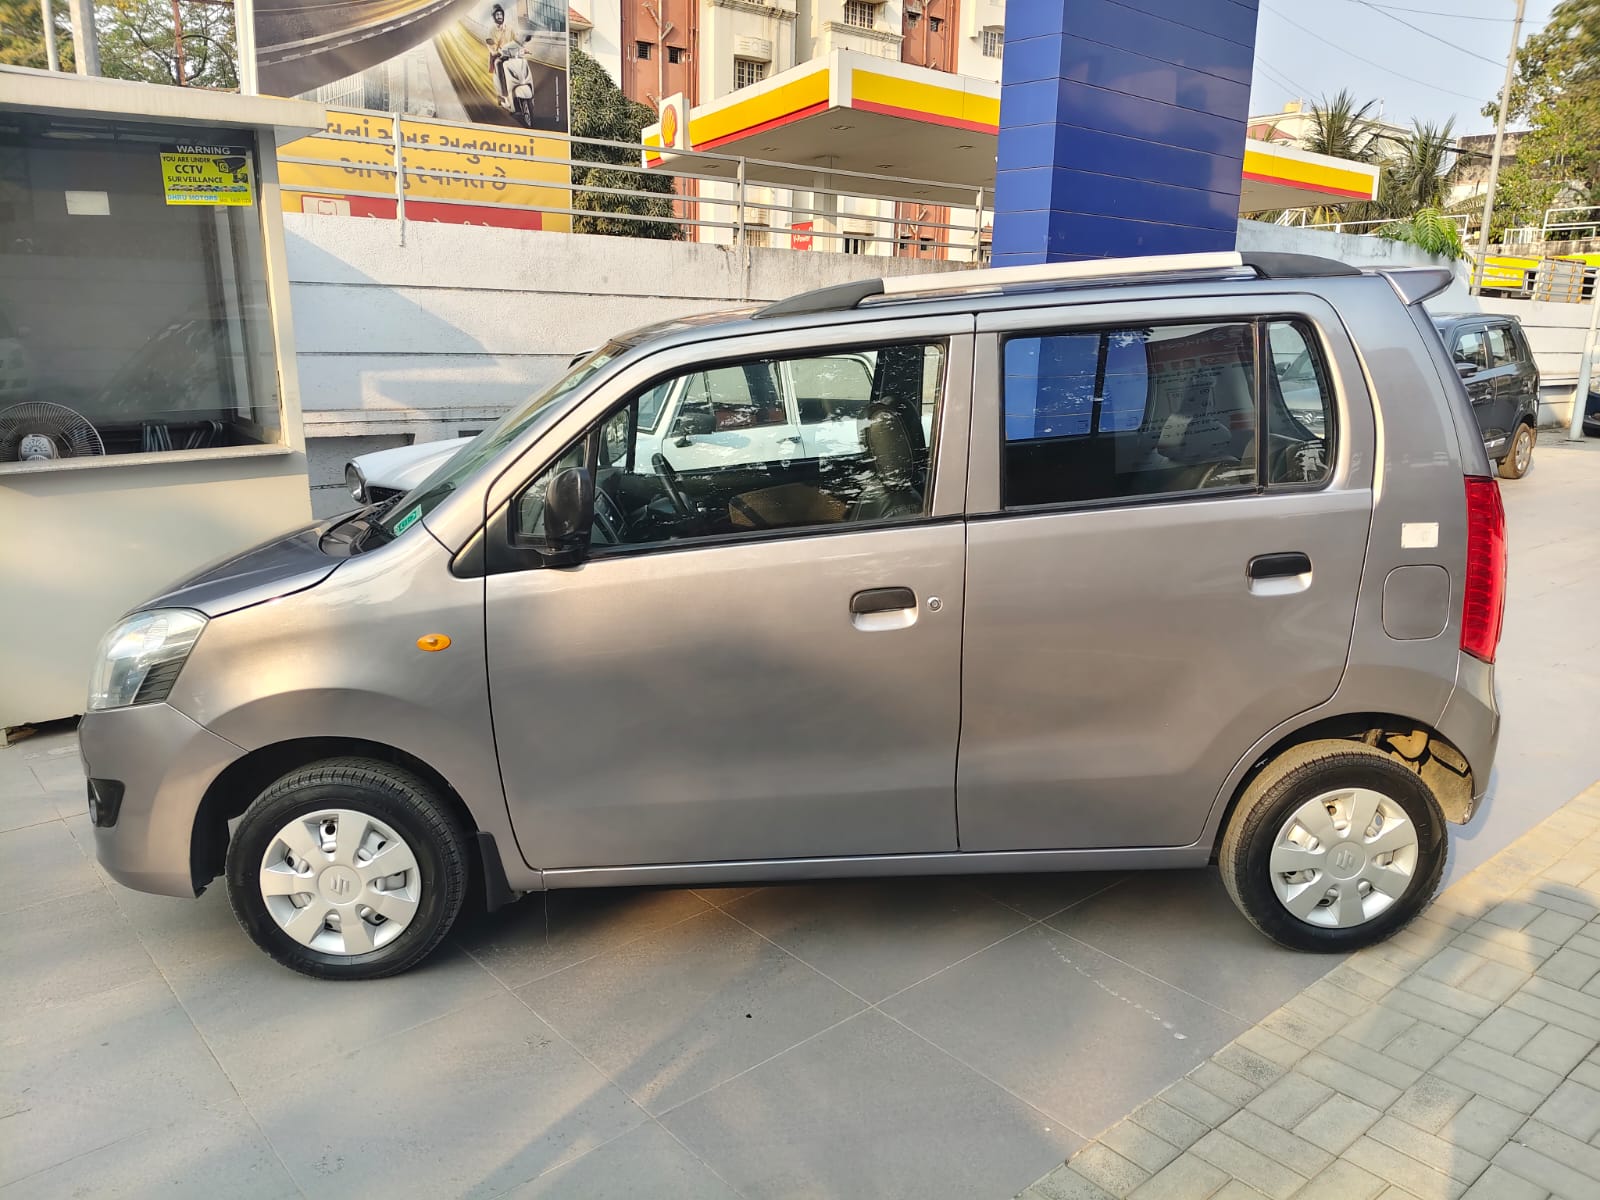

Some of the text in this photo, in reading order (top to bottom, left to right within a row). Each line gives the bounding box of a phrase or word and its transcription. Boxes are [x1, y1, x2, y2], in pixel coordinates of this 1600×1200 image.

[324, 119, 370, 147] લનાં
[176, 145, 231, 155] WARNING
[174, 164, 203, 174] CCTV
